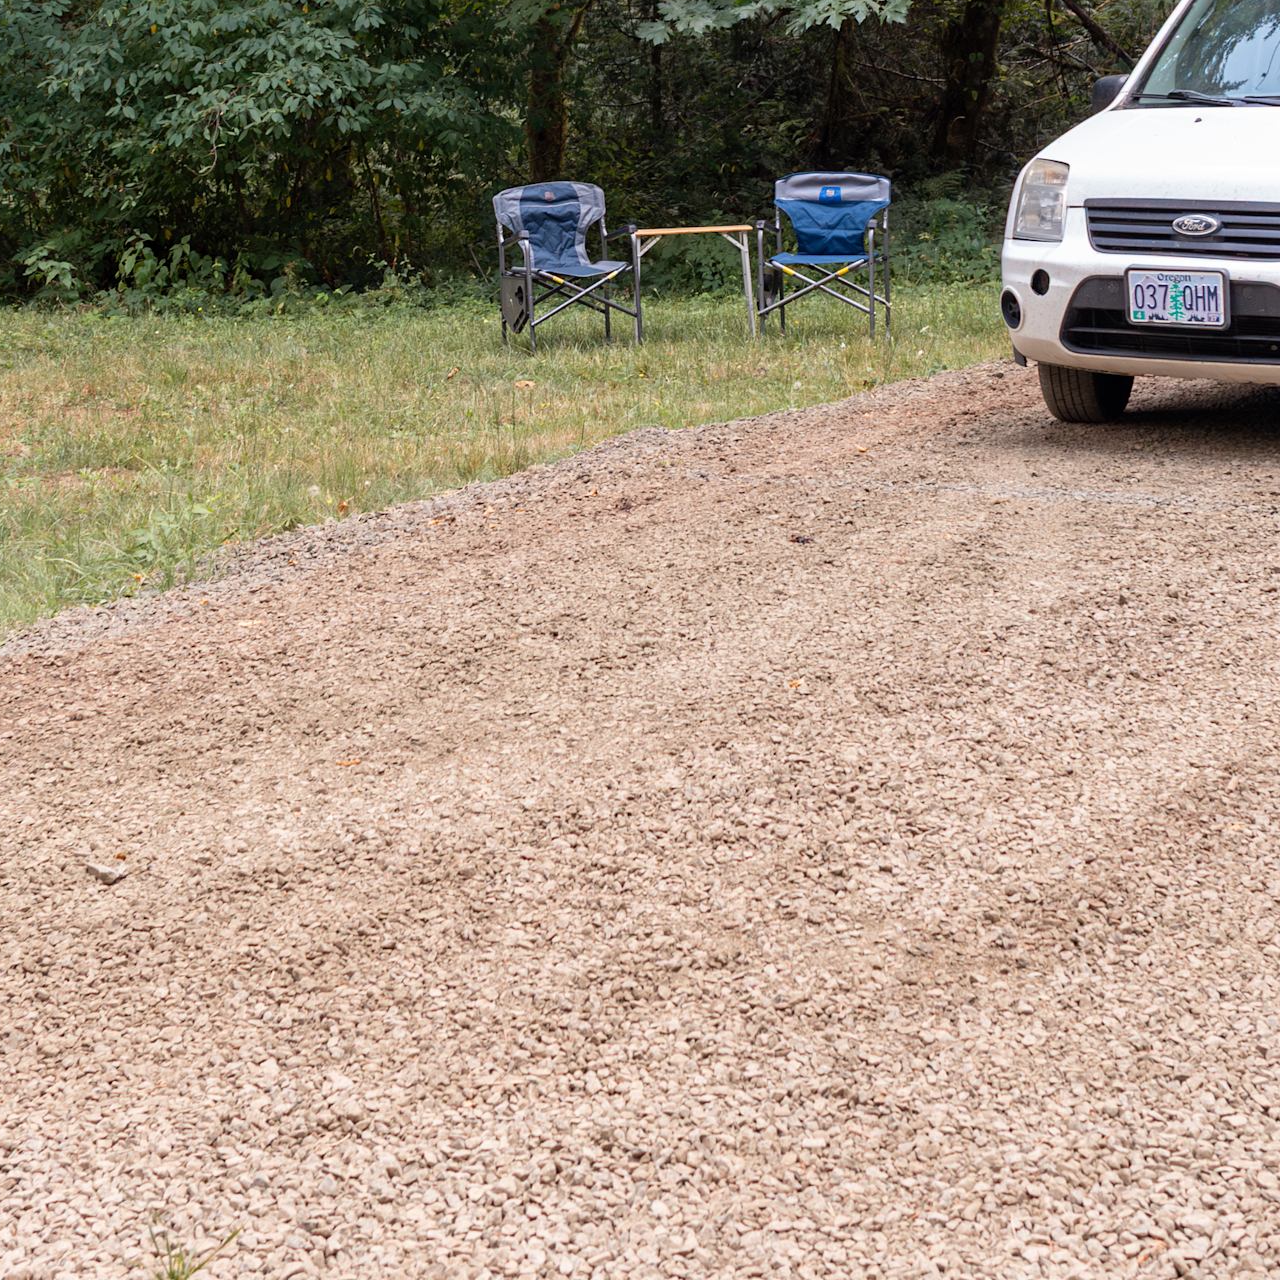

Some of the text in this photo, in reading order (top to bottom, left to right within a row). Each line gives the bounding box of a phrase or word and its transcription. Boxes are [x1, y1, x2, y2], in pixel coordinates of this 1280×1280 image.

[1178, 218, 1207, 231] Ford
[1157, 273, 1191, 283] Oregon
[1134, 284, 1219, 312] 037 QHM
